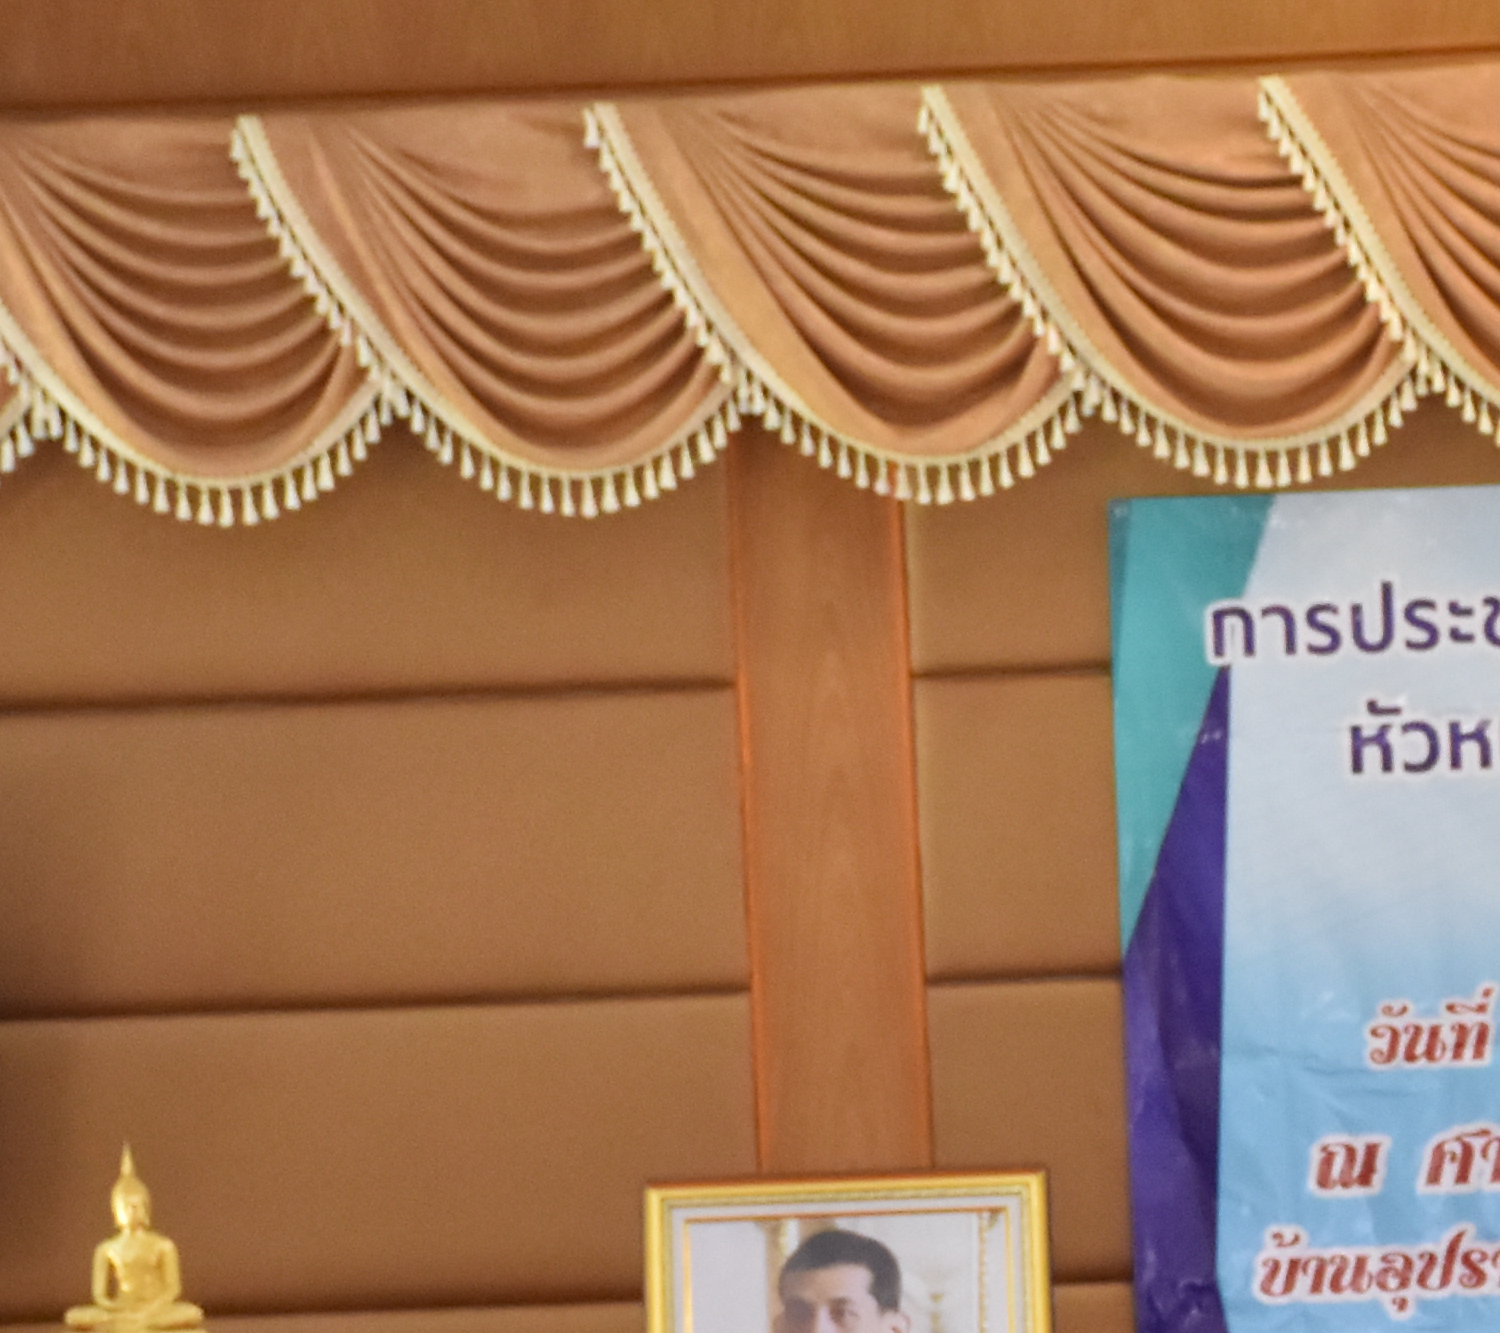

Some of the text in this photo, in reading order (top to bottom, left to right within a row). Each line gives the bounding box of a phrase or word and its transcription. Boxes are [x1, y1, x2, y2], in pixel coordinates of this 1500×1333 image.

[1368, 985, 1494, 1065] วันที่
[1315, 1140, 1382, 1192] ณ
